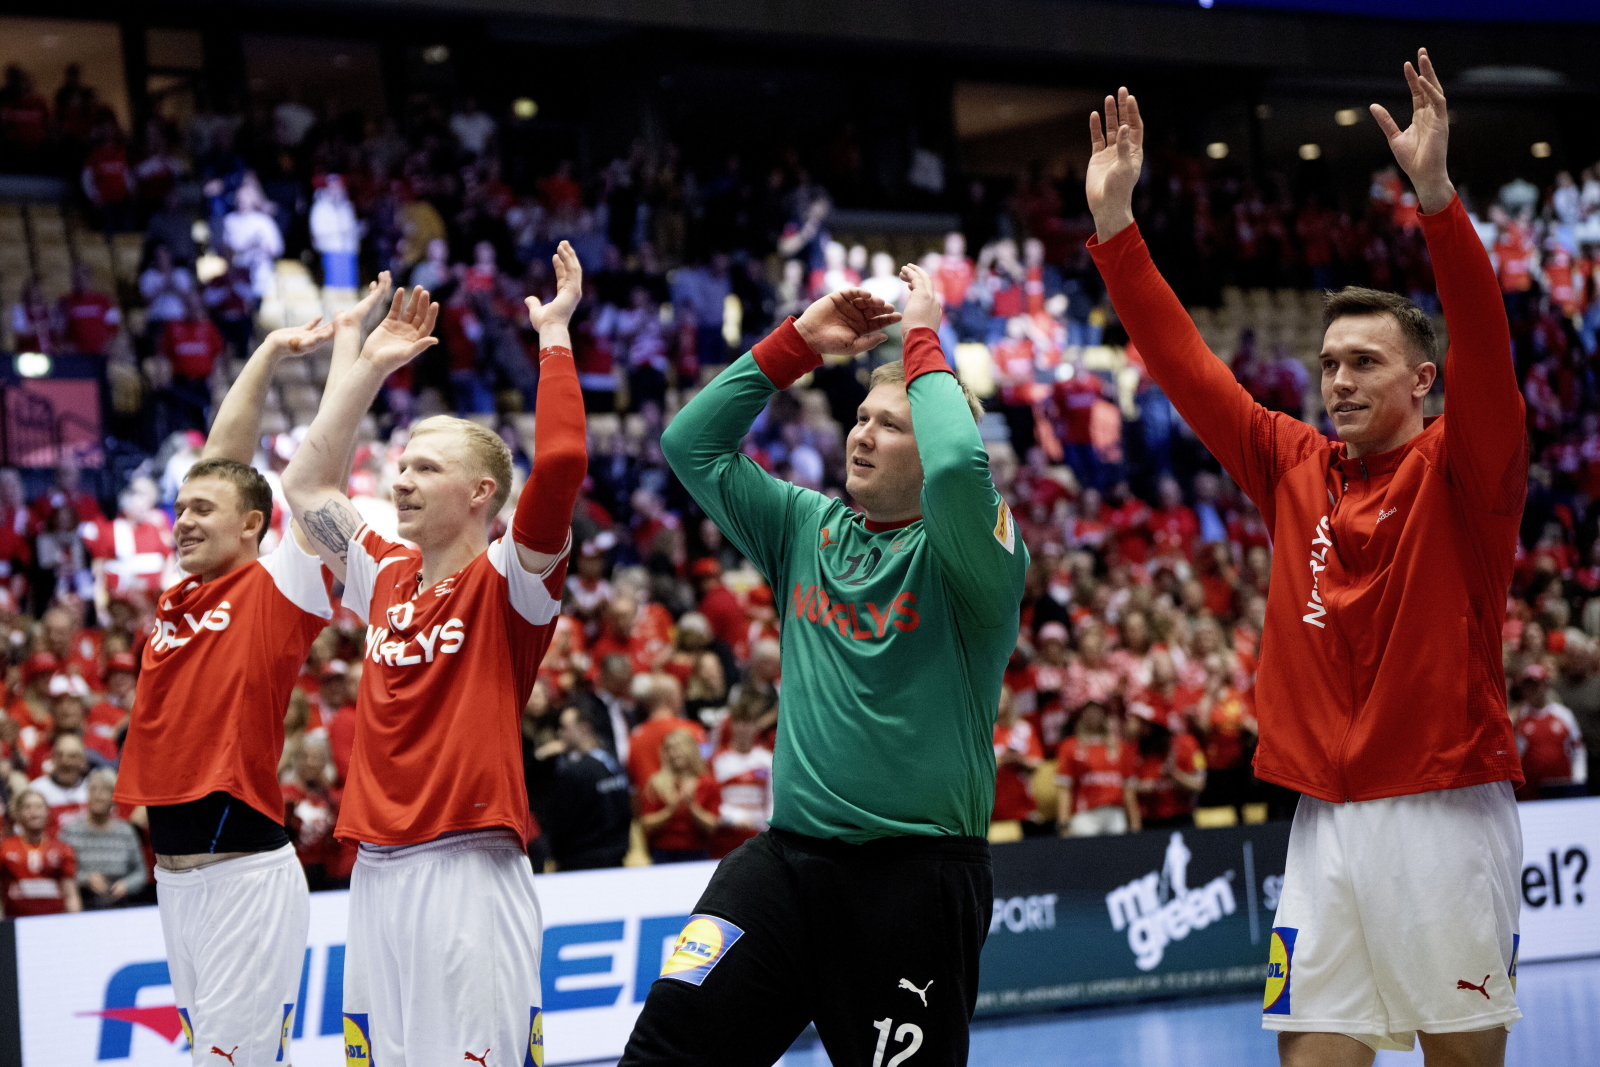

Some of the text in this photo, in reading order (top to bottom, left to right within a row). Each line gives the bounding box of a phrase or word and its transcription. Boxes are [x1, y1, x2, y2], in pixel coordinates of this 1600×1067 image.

[832, 547, 882, 586] 12
[787, 582, 920, 640] NORLYS
[1105, 869, 1162, 932] mr
[1127, 876, 1236, 972] green
[872, 1017, 924, 1067] 12
